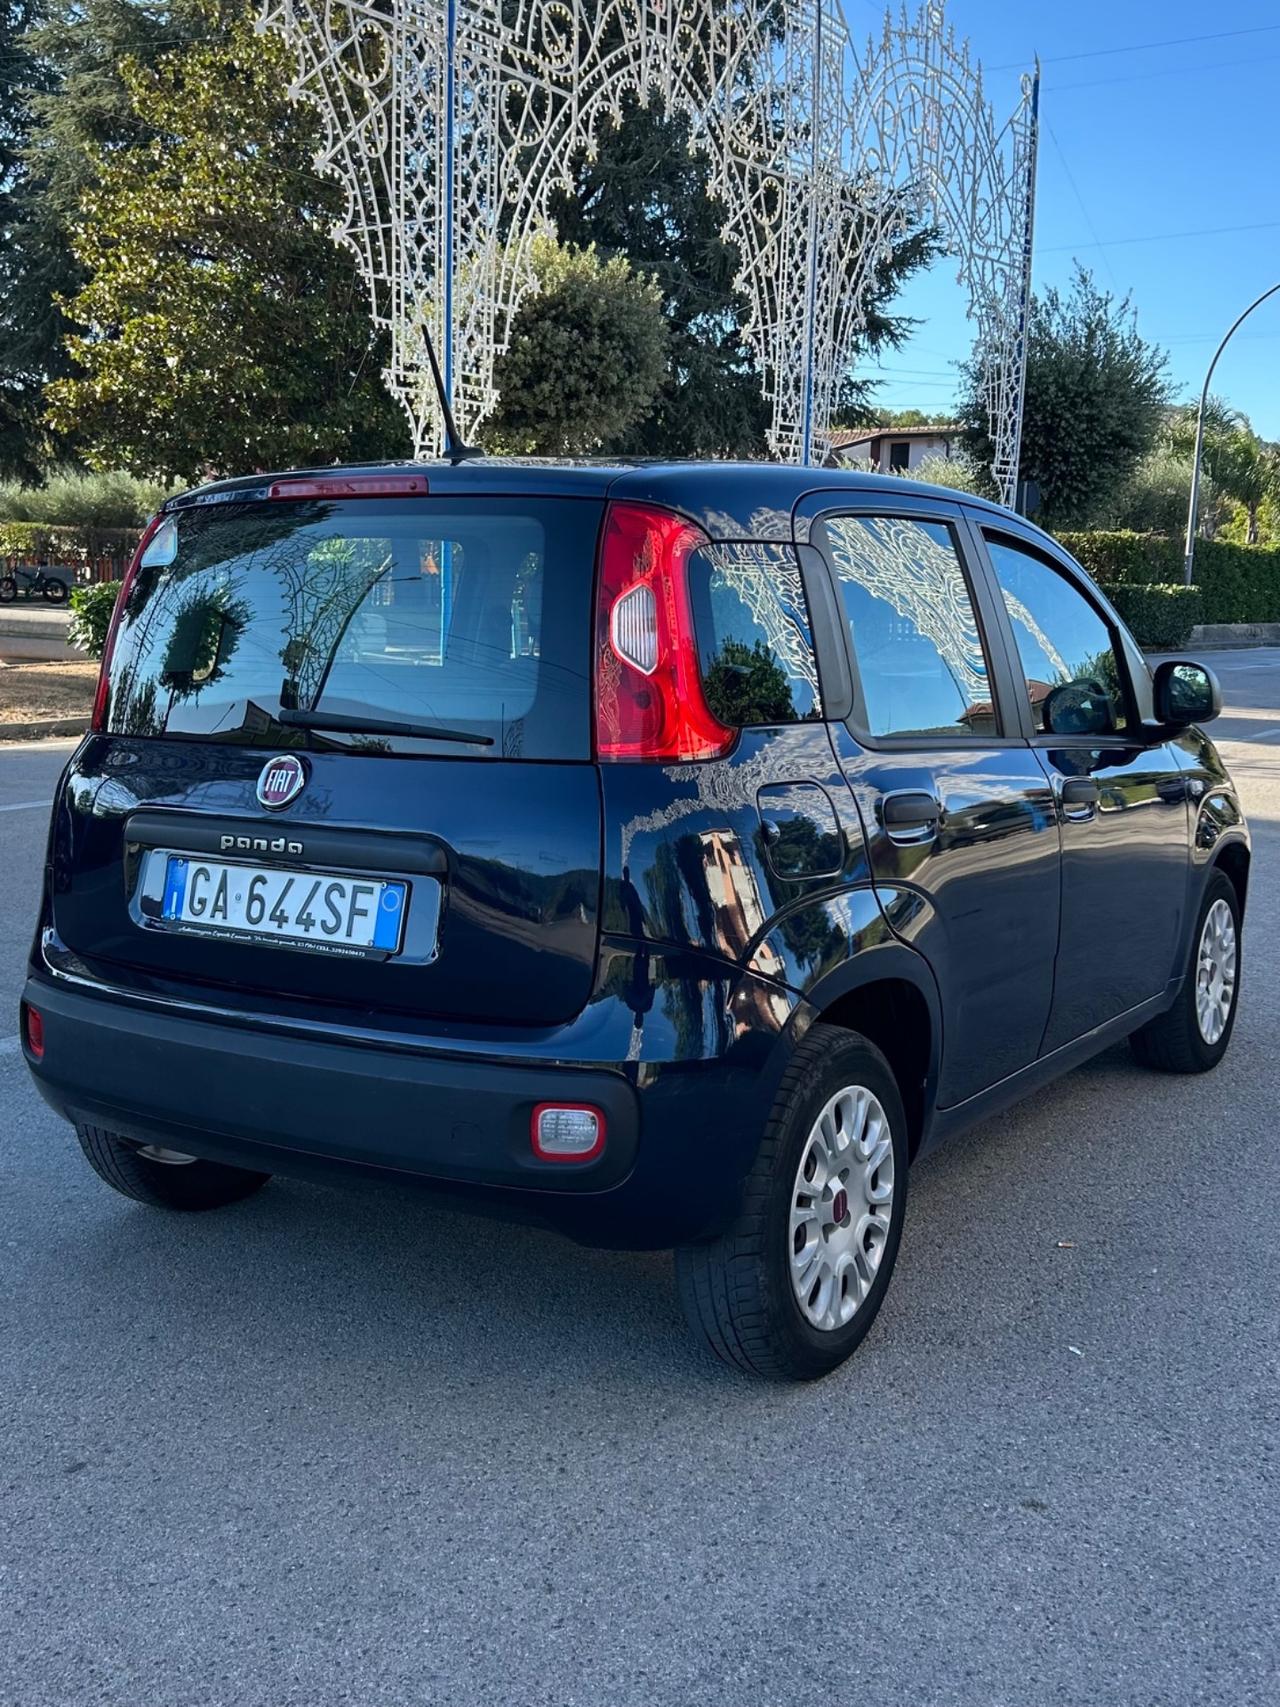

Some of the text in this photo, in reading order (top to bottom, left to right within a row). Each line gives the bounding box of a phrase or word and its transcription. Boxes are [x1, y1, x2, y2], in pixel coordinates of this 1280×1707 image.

[265, 769, 295, 793] FIAT
[220, 834, 303, 854] panda
[188, 866, 374, 938] GA 644SF
